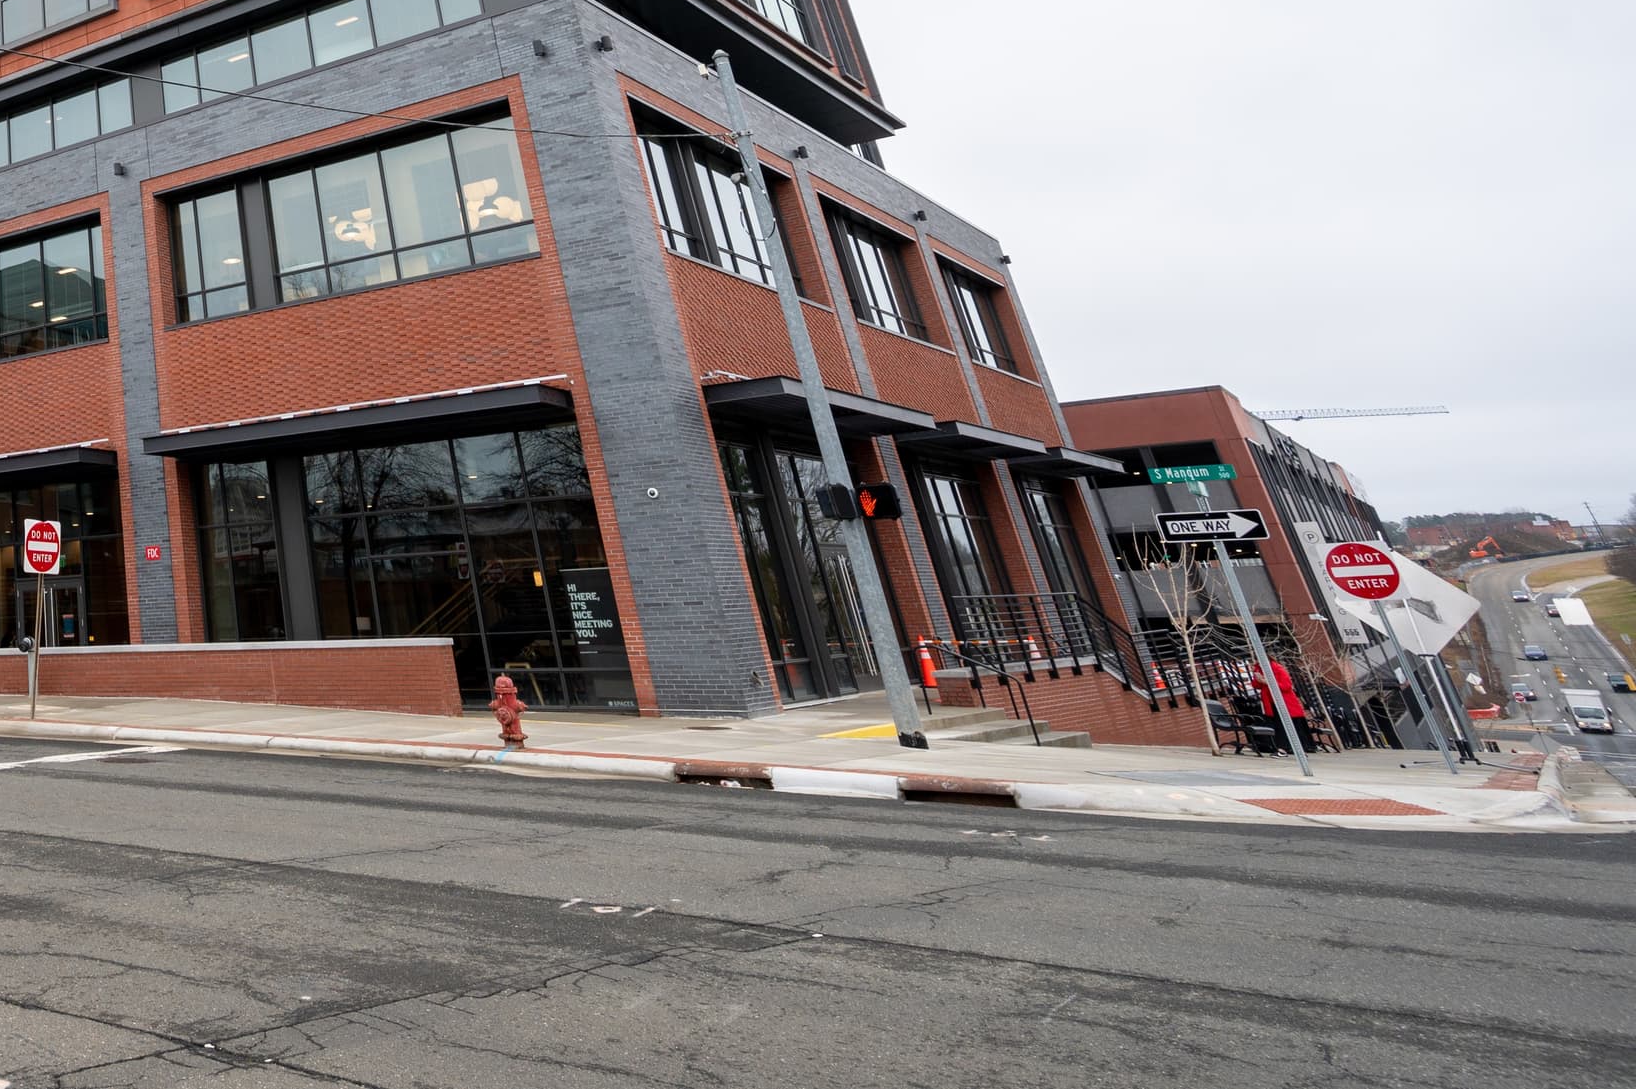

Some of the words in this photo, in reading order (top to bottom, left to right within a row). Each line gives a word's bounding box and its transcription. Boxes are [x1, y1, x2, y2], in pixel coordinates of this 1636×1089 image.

[1154, 468, 1162, 480] S
[1166, 467, 1210, 480] Mangum
[1170, 521, 1197, 533] ONE
[1202, 520, 1231, 532] WAY
[31, 530, 41, 539] DO
[43, 531, 56, 540] NOT
[32, 553, 53, 563] ENTER
[147, 548, 159, 558] FDC
[1331, 554, 1350, 564] DO
[1354, 552, 1381, 563] NOT
[567, 584, 577, 592] HI
[1347, 578, 1389, 590] ENTER
[568, 592, 600, 601] THERE,
[570, 602, 587, 610] IT'S
[572, 611, 593, 619] NICE
[574, 620, 613, 628] MEETING
[576, 629, 597, 638] YOU.
